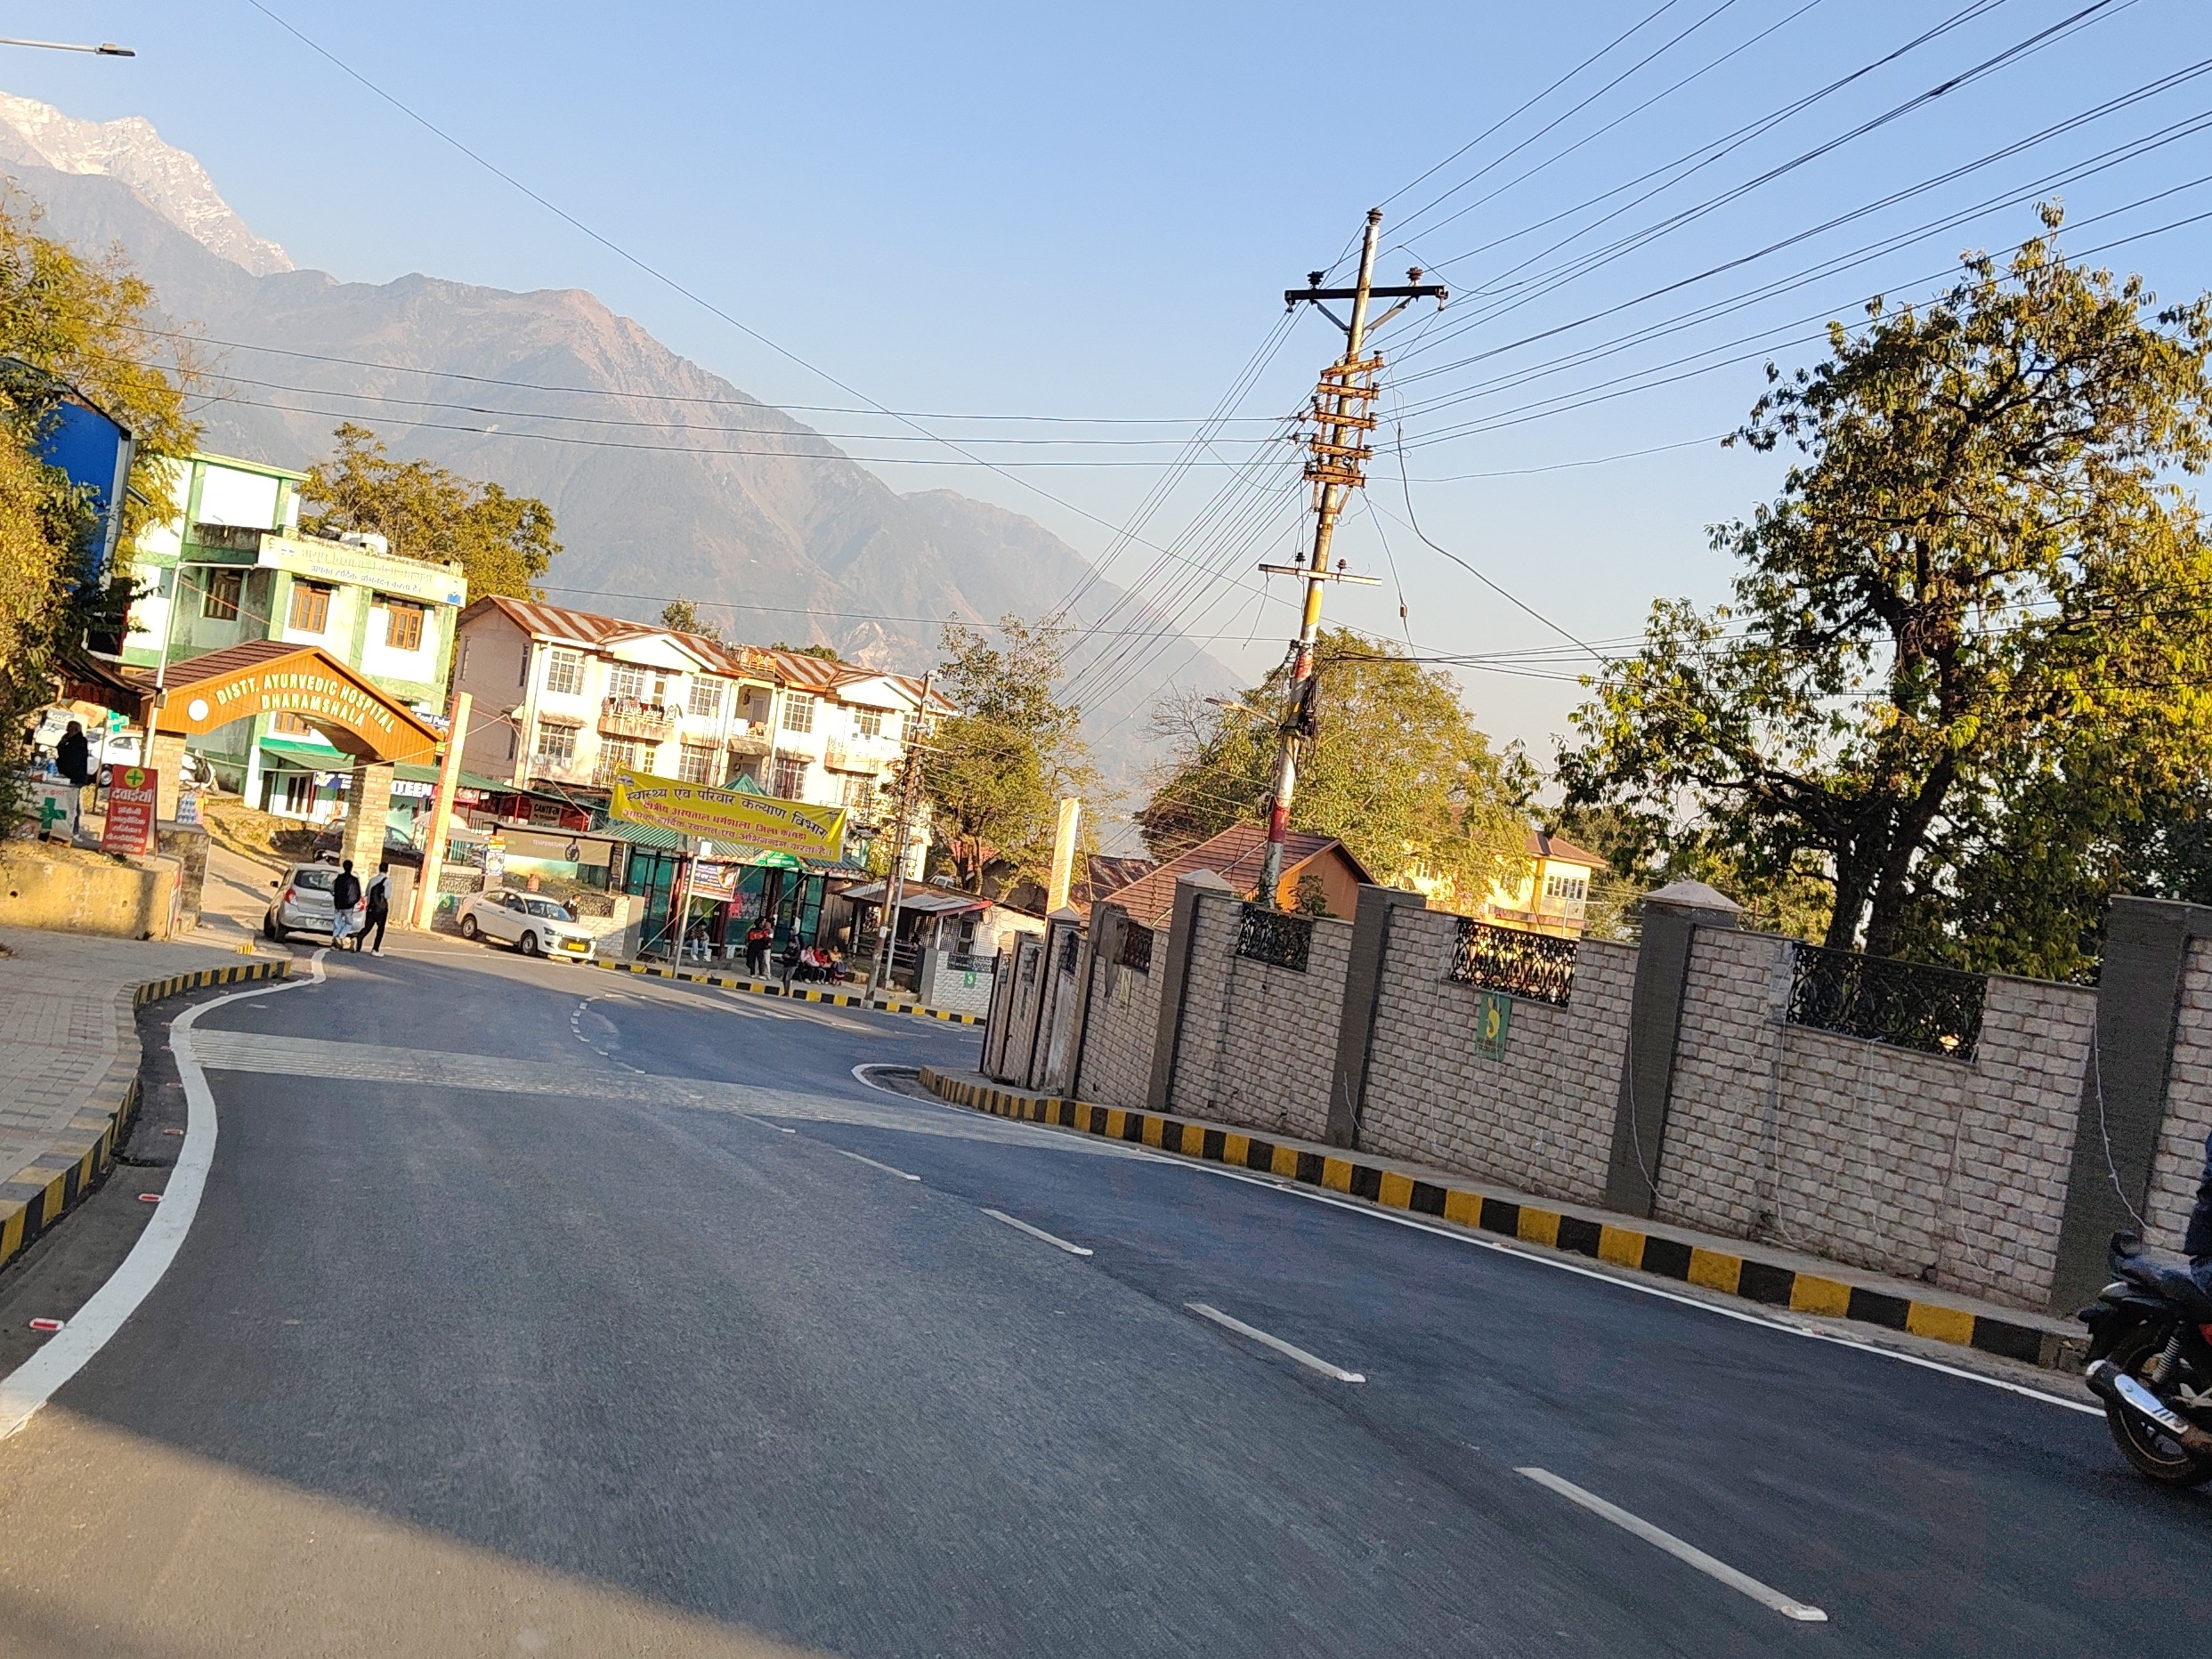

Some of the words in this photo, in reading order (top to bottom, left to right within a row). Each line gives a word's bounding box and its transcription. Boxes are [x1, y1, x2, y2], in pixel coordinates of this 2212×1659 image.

[215, 677, 260, 706] DISTT.
[263, 673, 339, 696] AYURVEDIC
[339, 685, 396, 733] HOSPITAL
[261, 693, 366, 727] DHARAMSHALA
[623, 809, 653, 821] आपका
[658, 815, 685, 829] हार्दिक
[739, 832, 787, 848] अभिनन्दन
[790, 842, 814, 854] करता
[627, 789, 668, 802] स्वास्थ्य
[697, 788, 735, 805] परिवार
[741, 797, 787, 820] कल्याण
[791, 811, 828, 839] विभाग
[672, 806, 709, 821] अस्पताल
[713, 815, 750, 830] धर्मशाला
[756, 823, 778, 836] जिला
